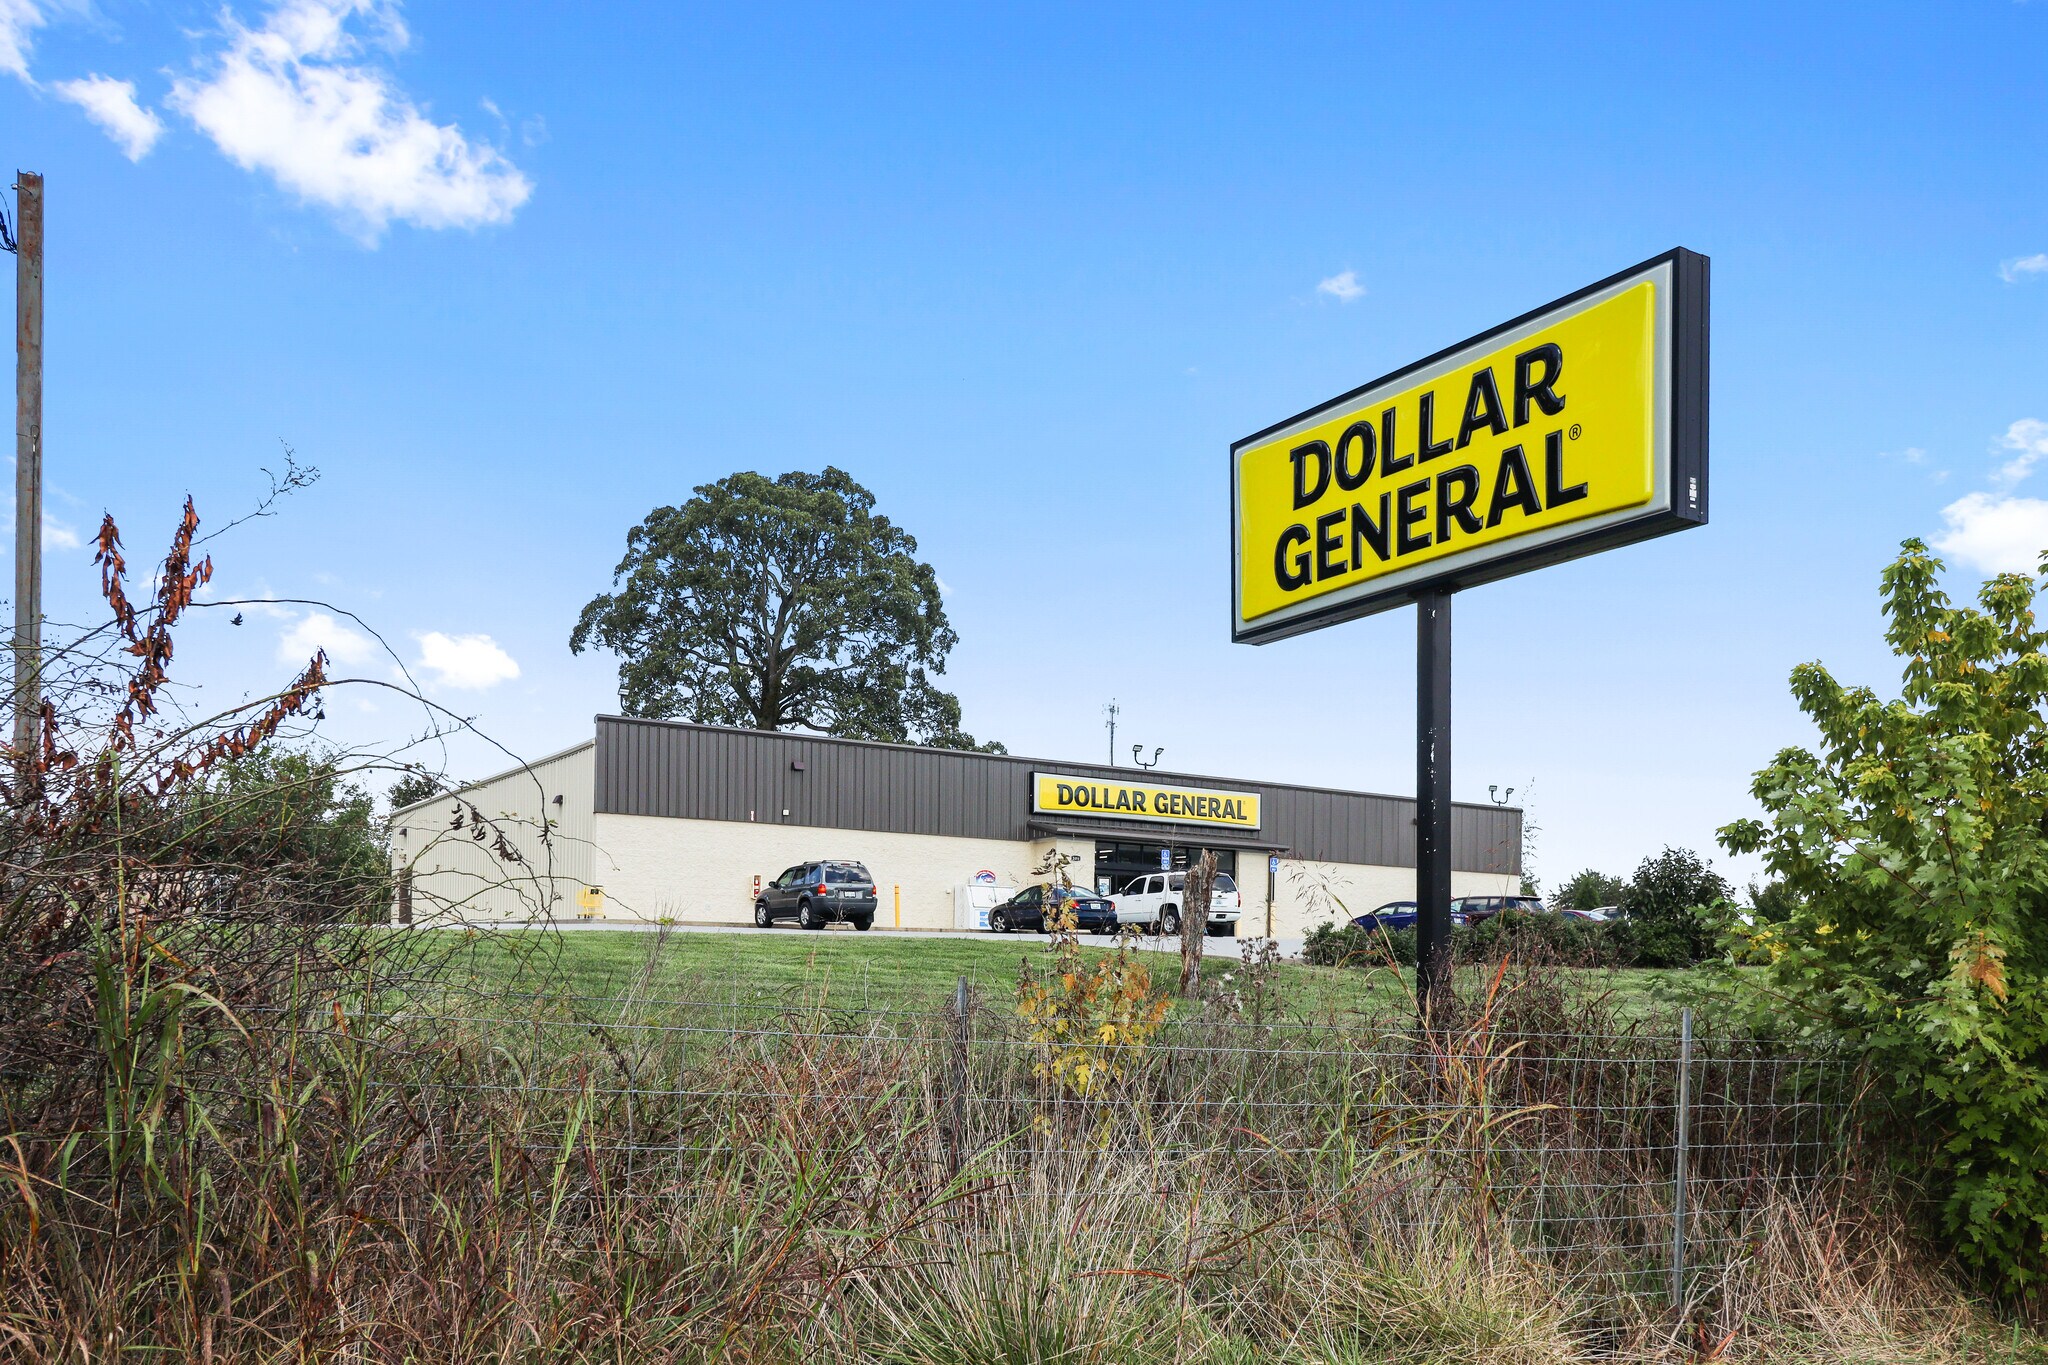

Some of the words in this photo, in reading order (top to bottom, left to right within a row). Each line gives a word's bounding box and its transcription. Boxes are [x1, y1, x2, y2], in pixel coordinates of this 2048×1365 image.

[1289, 342, 1566, 511] DOLLAR
[1056, 783, 1146, 812] DOLLAR
[1154, 792, 1247, 820] GENERAL
